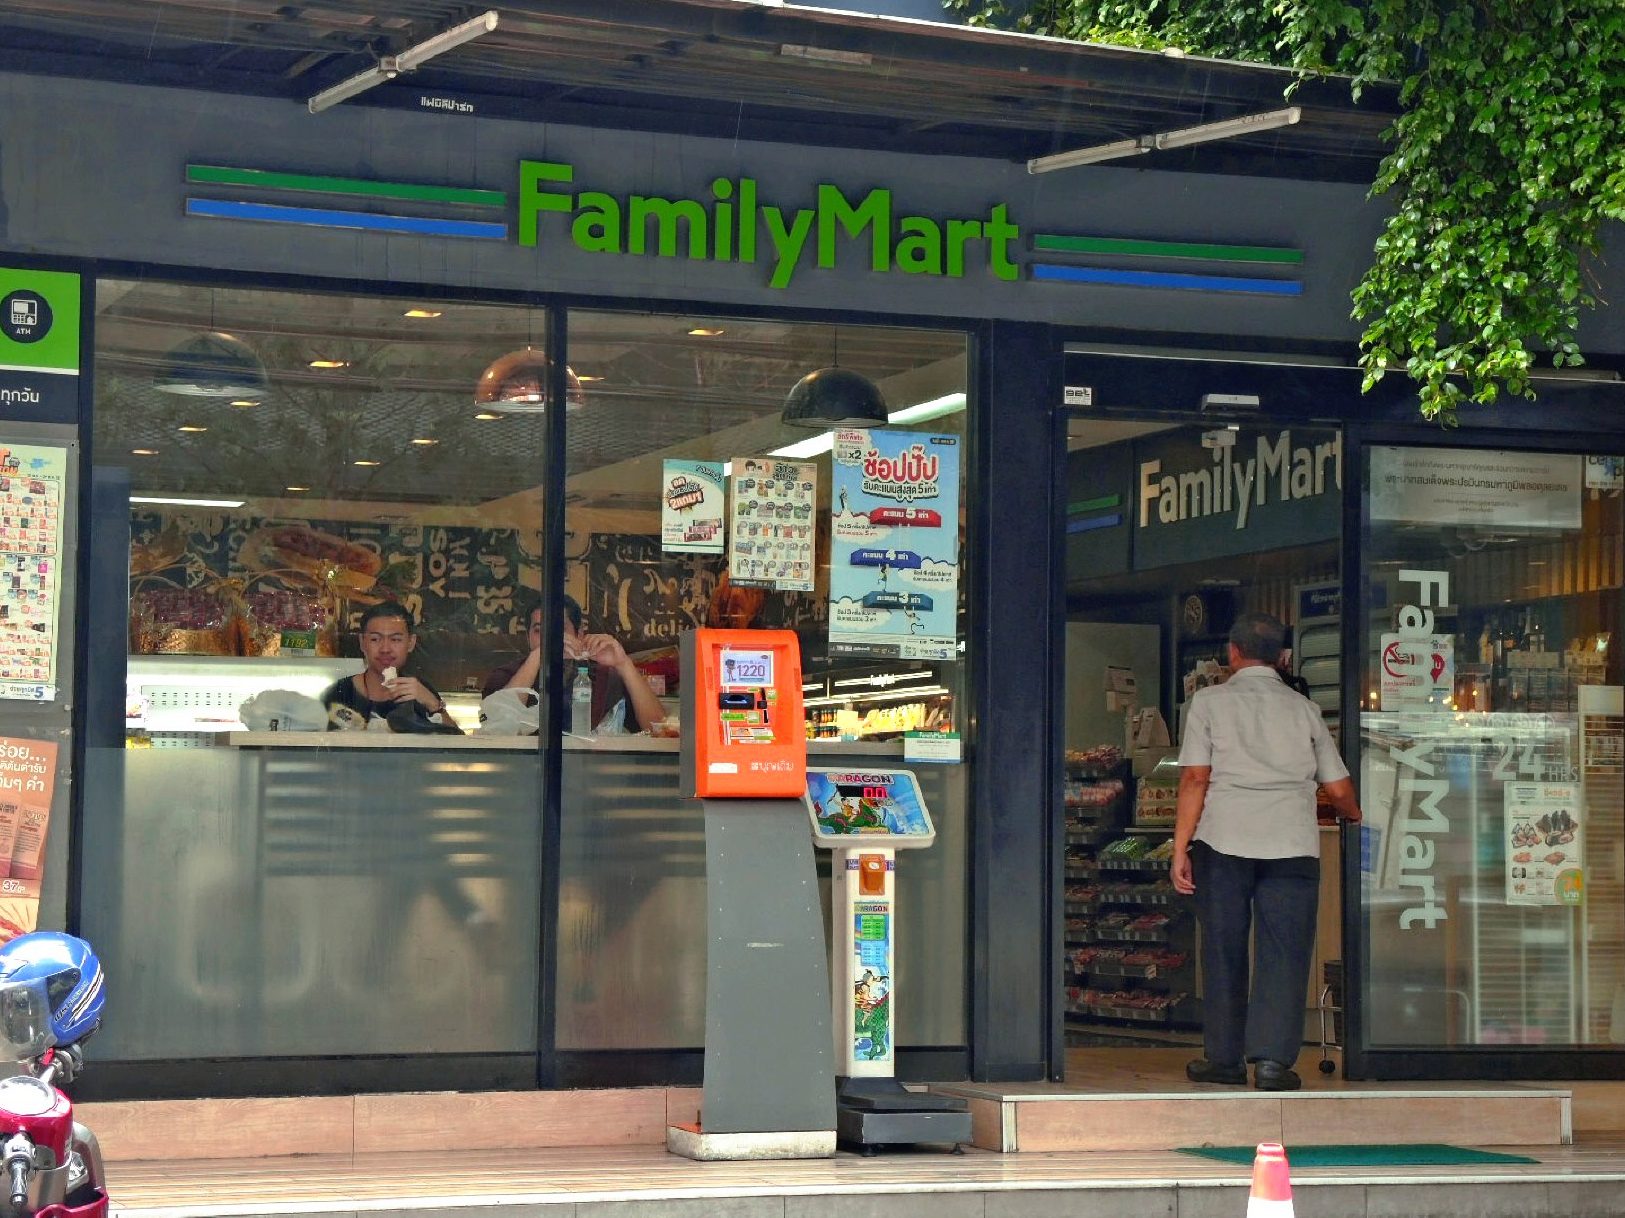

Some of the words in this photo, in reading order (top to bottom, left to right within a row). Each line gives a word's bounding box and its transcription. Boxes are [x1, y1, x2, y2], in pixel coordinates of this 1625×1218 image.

[518, 159, 1019, 289] FamilyMart
[1139, 429, 1342, 529] FamilyMart
[737, 664, 766, 677] 1220
